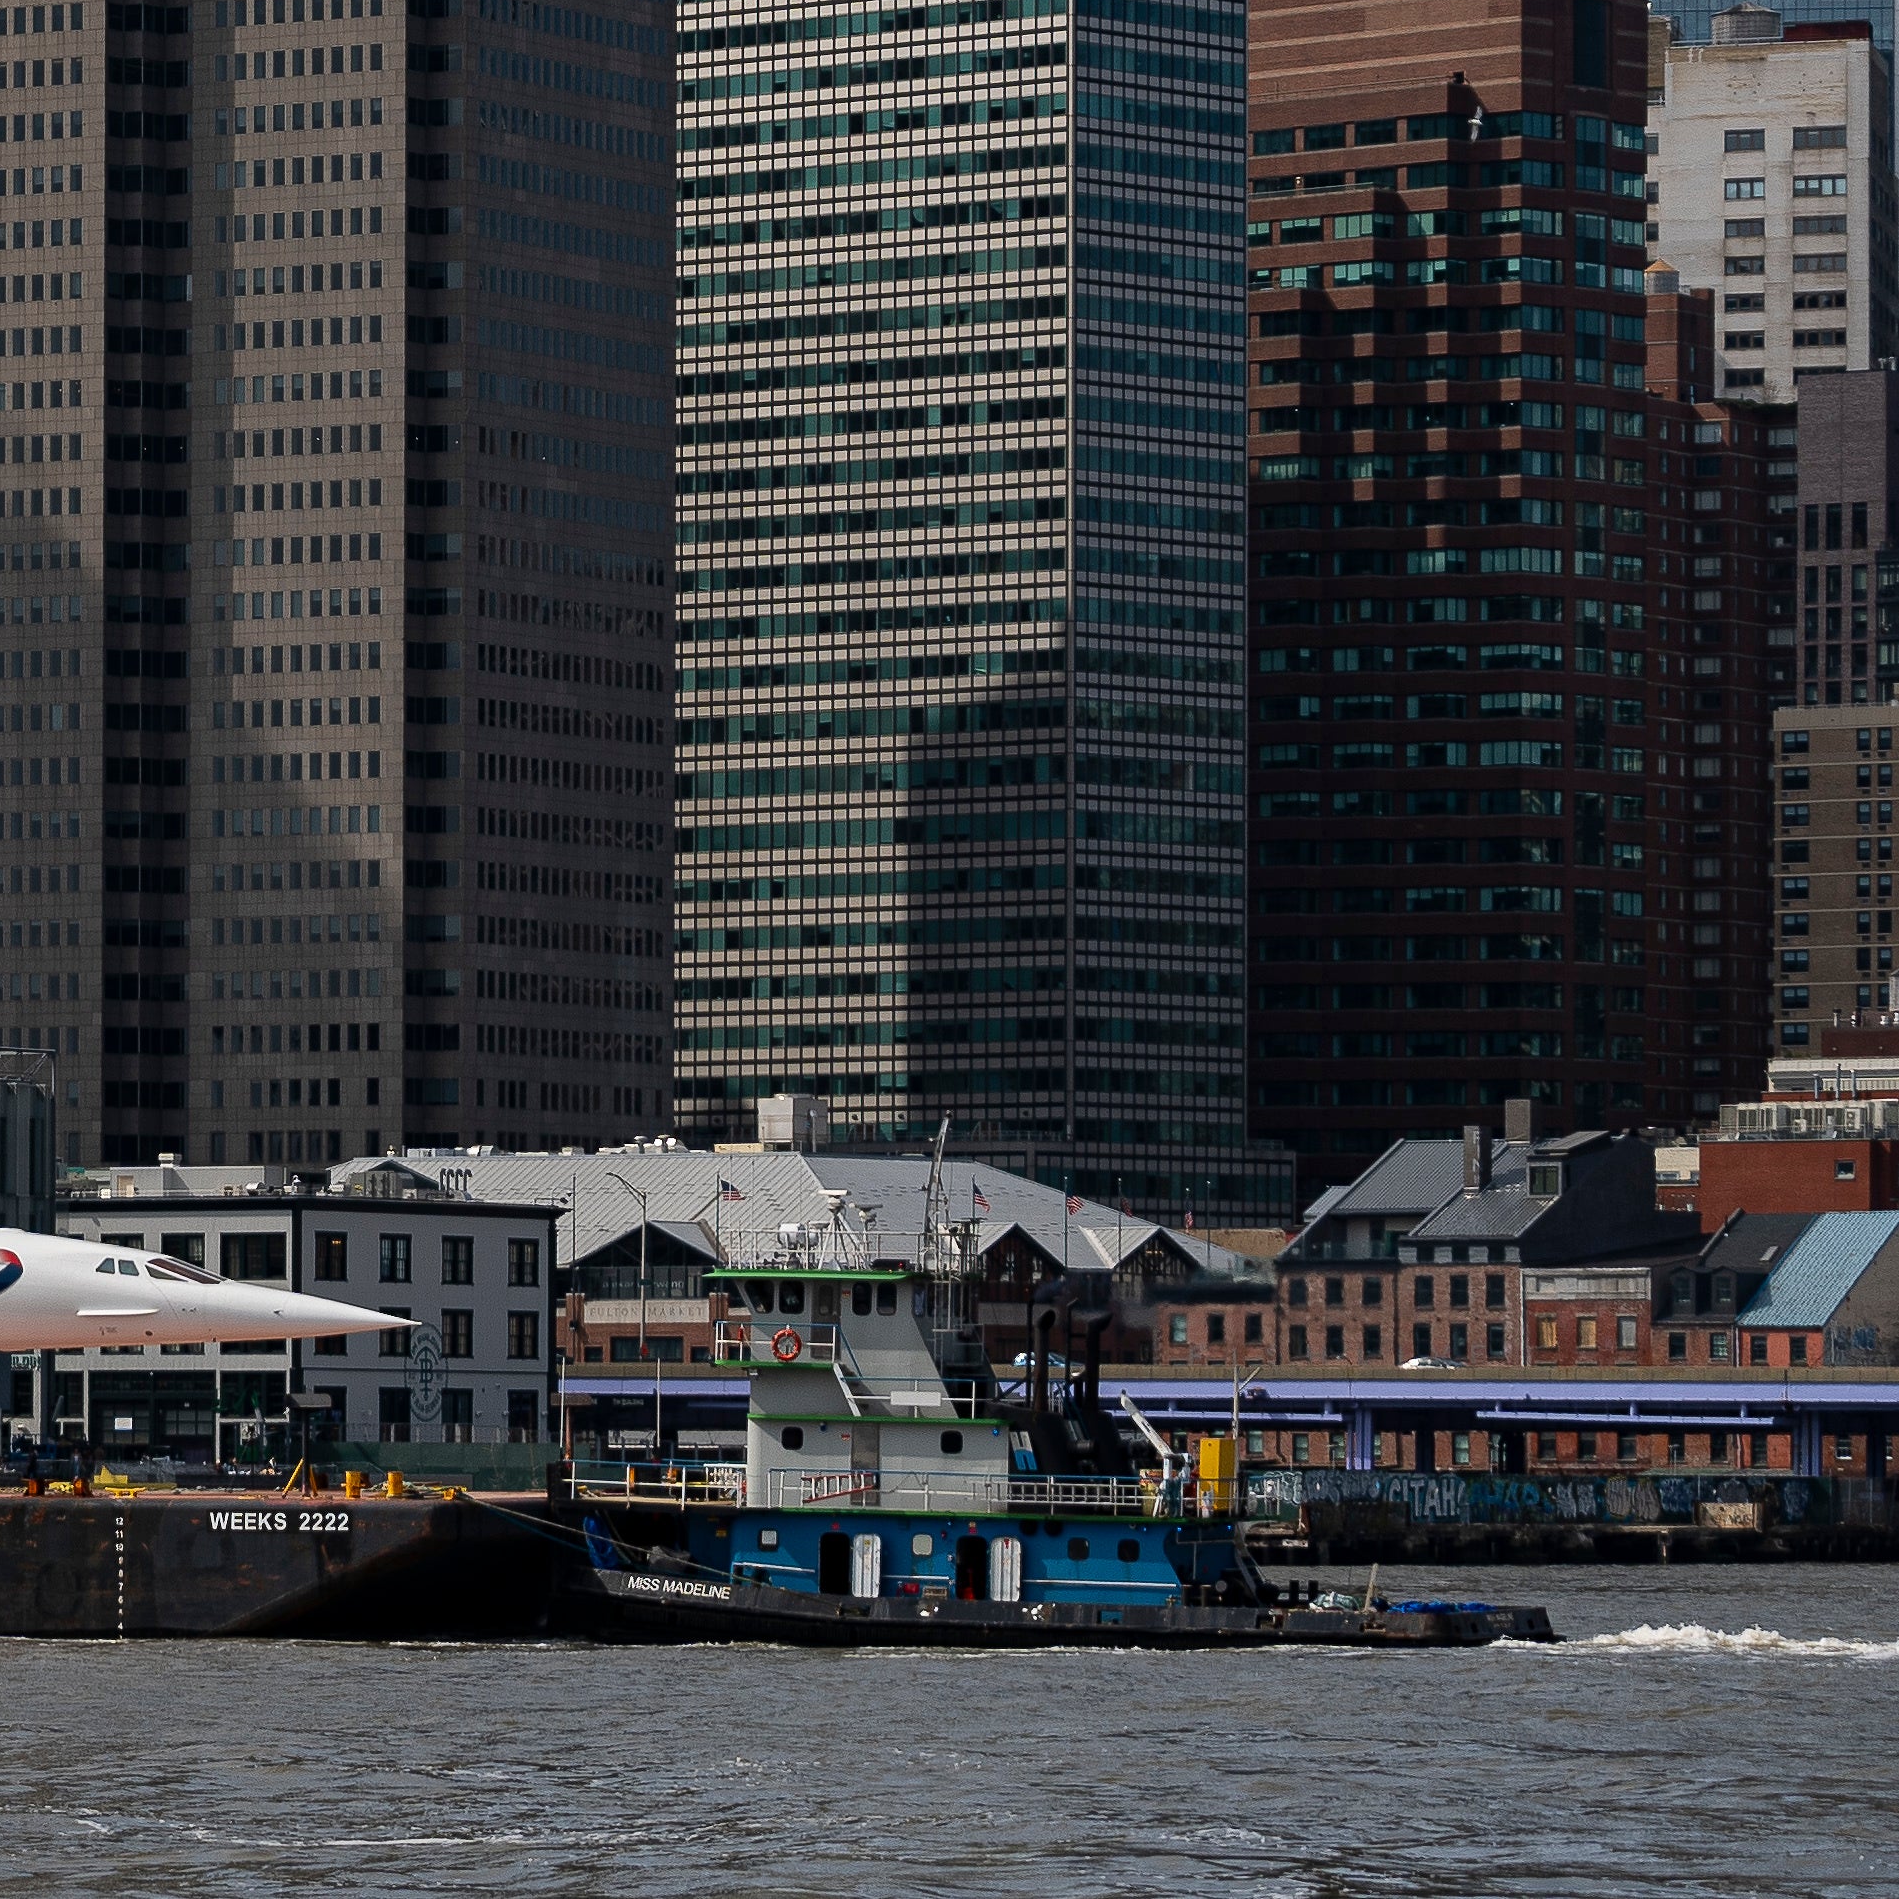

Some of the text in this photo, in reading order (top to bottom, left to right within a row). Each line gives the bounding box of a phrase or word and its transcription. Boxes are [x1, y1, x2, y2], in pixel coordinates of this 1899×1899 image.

[589, 1306, 702, 1317] FULTON MARKET
[209, 1511, 350, 1531] WEEKS 2222
[627, 1575, 731, 1600] MISS MADELINE
